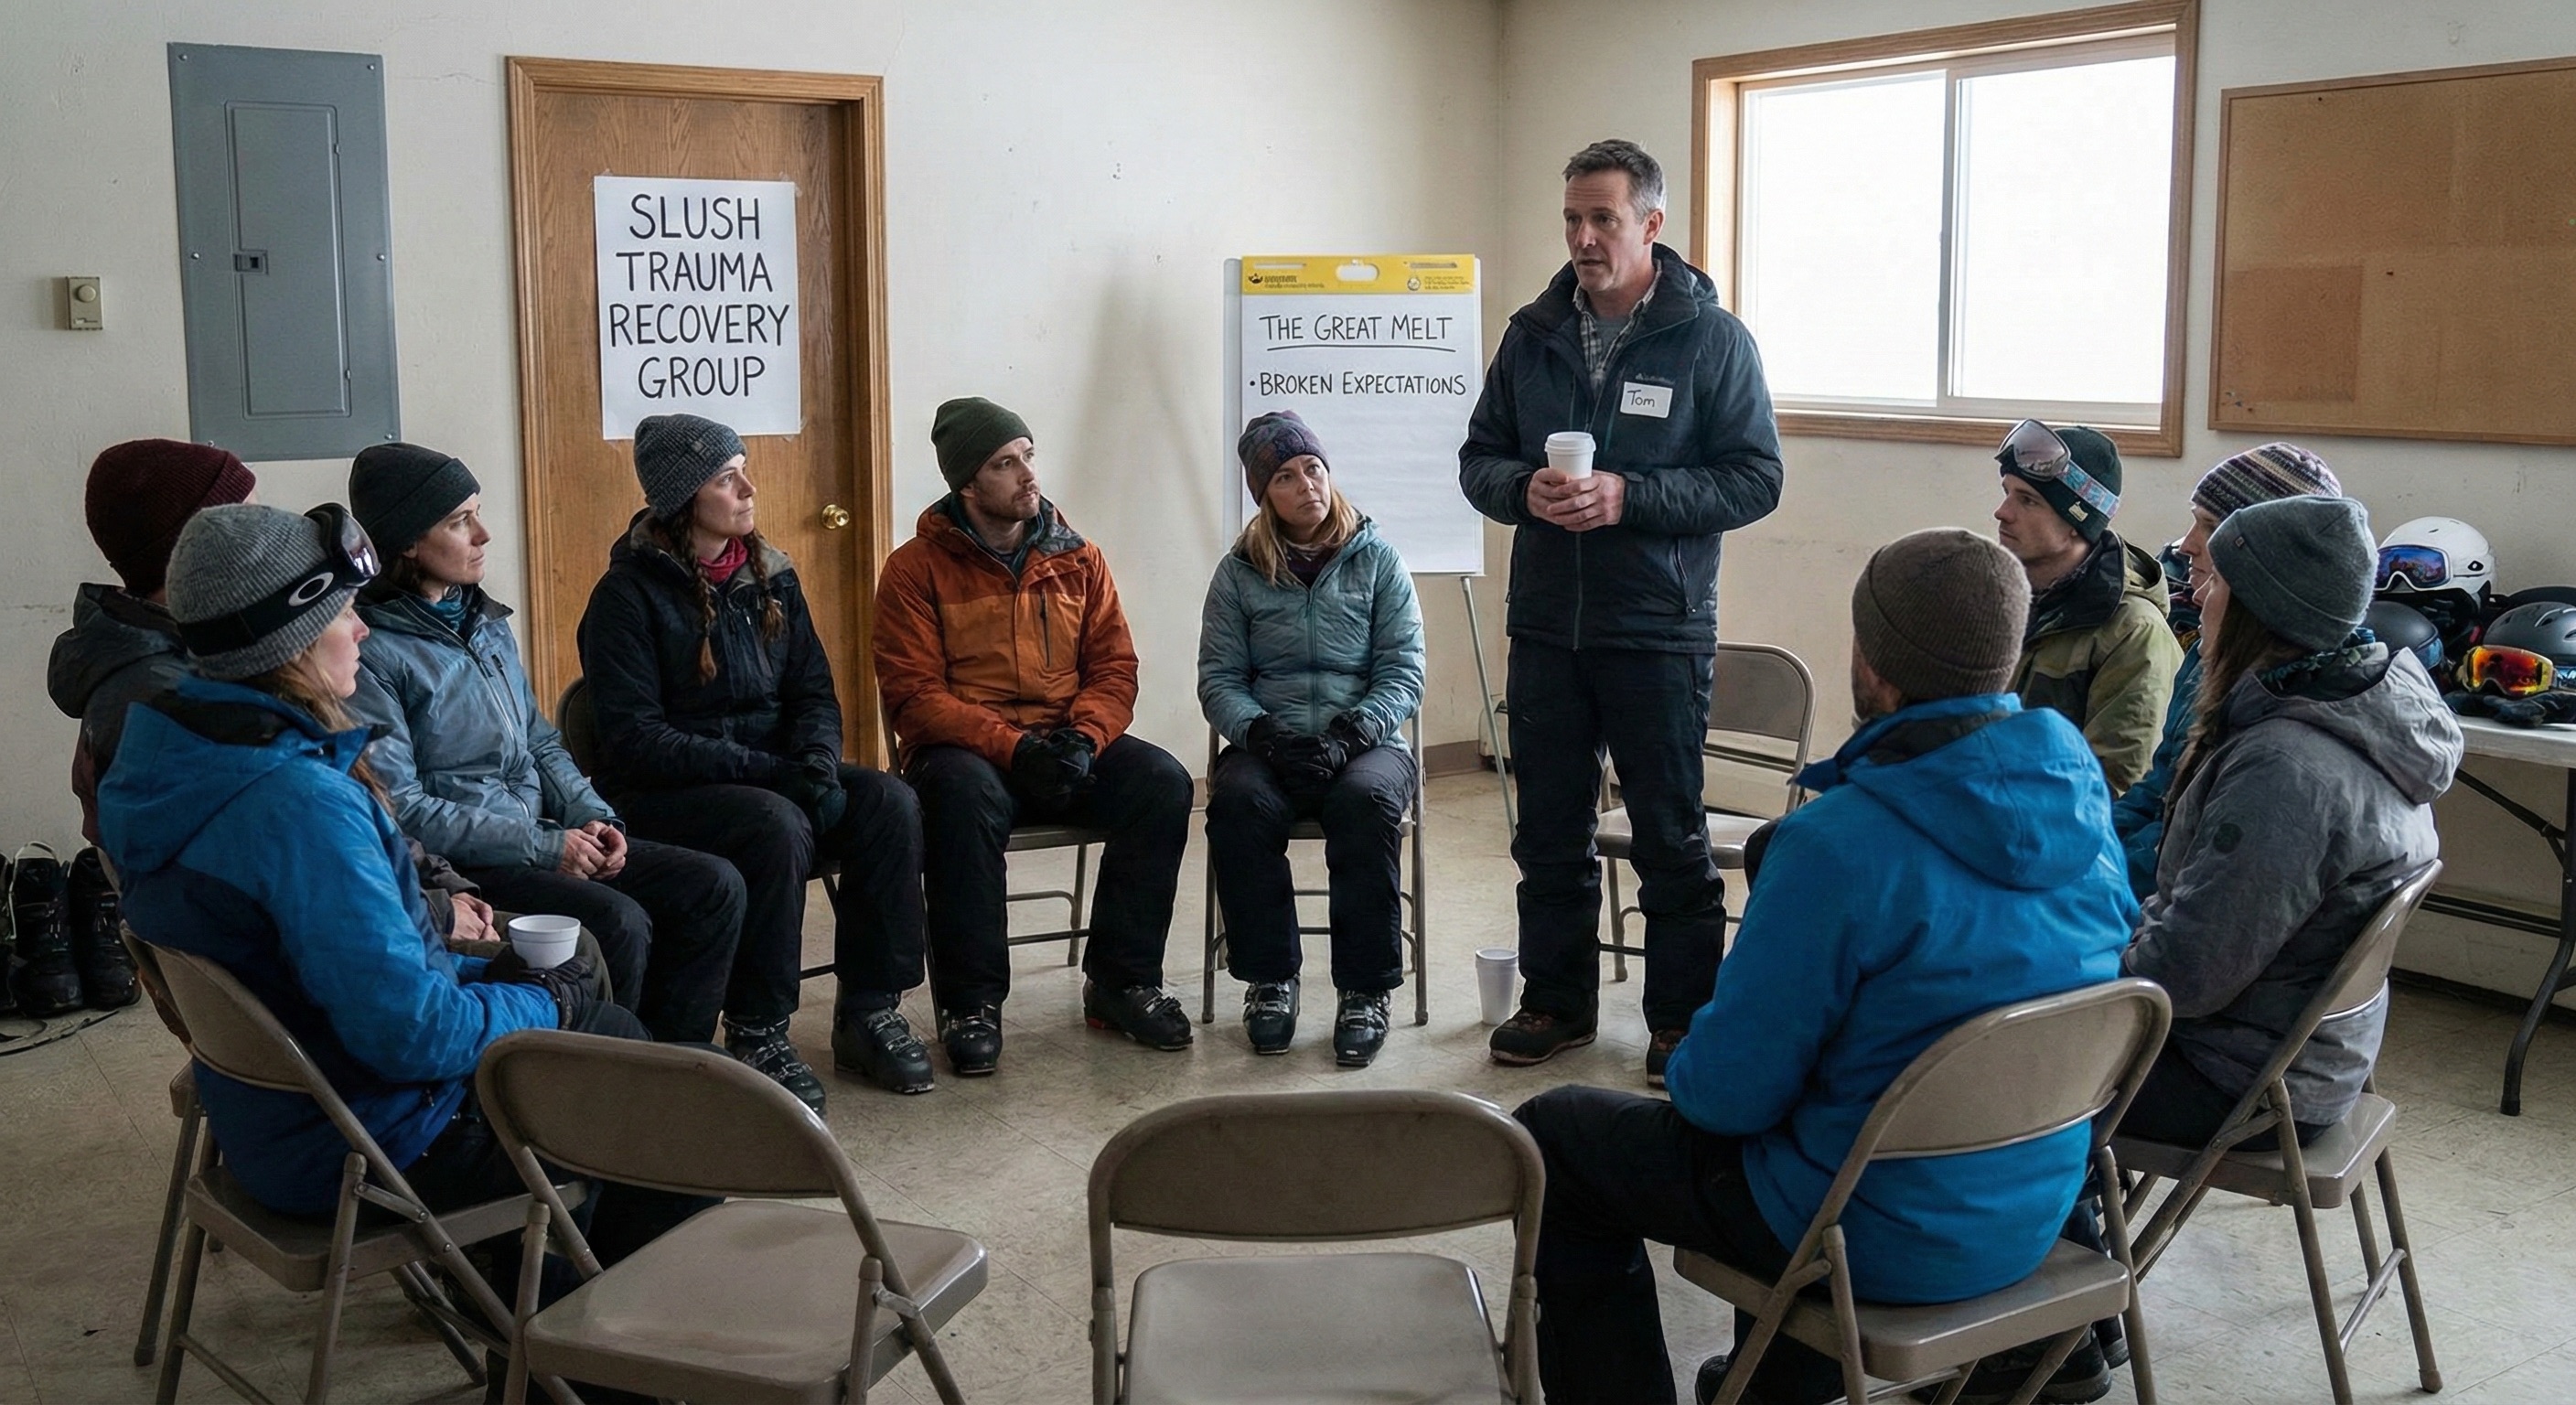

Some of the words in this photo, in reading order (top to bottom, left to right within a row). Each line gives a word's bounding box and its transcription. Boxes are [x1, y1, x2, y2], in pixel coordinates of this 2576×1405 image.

[628, 193, 760, 240] SLUSH
[616, 252, 773, 293] TRAUMA
[609, 303, 790, 348] RECOVERY
[1259, 314, 1304, 340] THE
[1314, 314, 1382, 341] GREAT
[1391, 314, 1453, 340] MELT
[638, 355, 765, 399] GROUP
[1261, 371, 1333, 396] BROKEN
[1343, 371, 1466, 396] EXPECTATIONS
[1626, 389, 1655, 407] Tom
